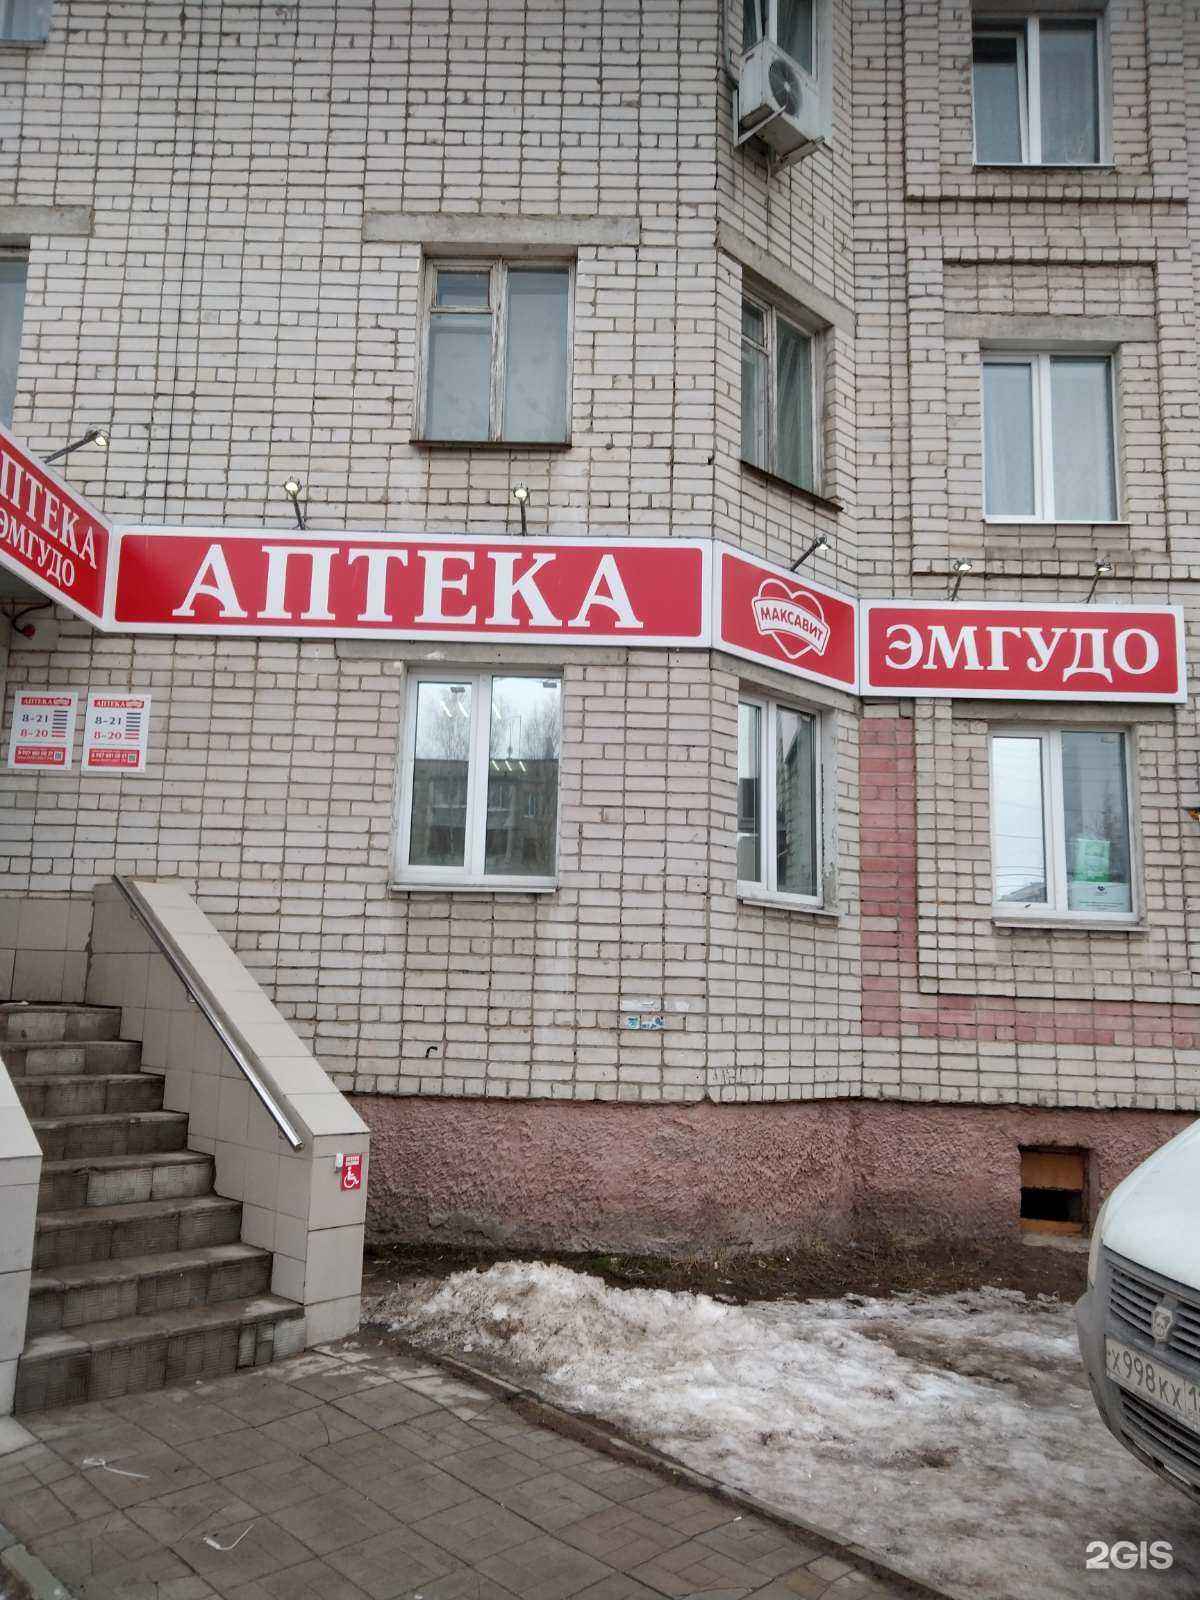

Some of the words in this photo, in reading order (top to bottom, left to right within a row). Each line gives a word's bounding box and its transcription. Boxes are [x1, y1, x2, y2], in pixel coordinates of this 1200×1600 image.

[172, 543, 645, 629] АПТЕКА
[760, 606, 824, 641] МАКСАВИТ
[884, 623, 1160, 684] ЭМГУДО
